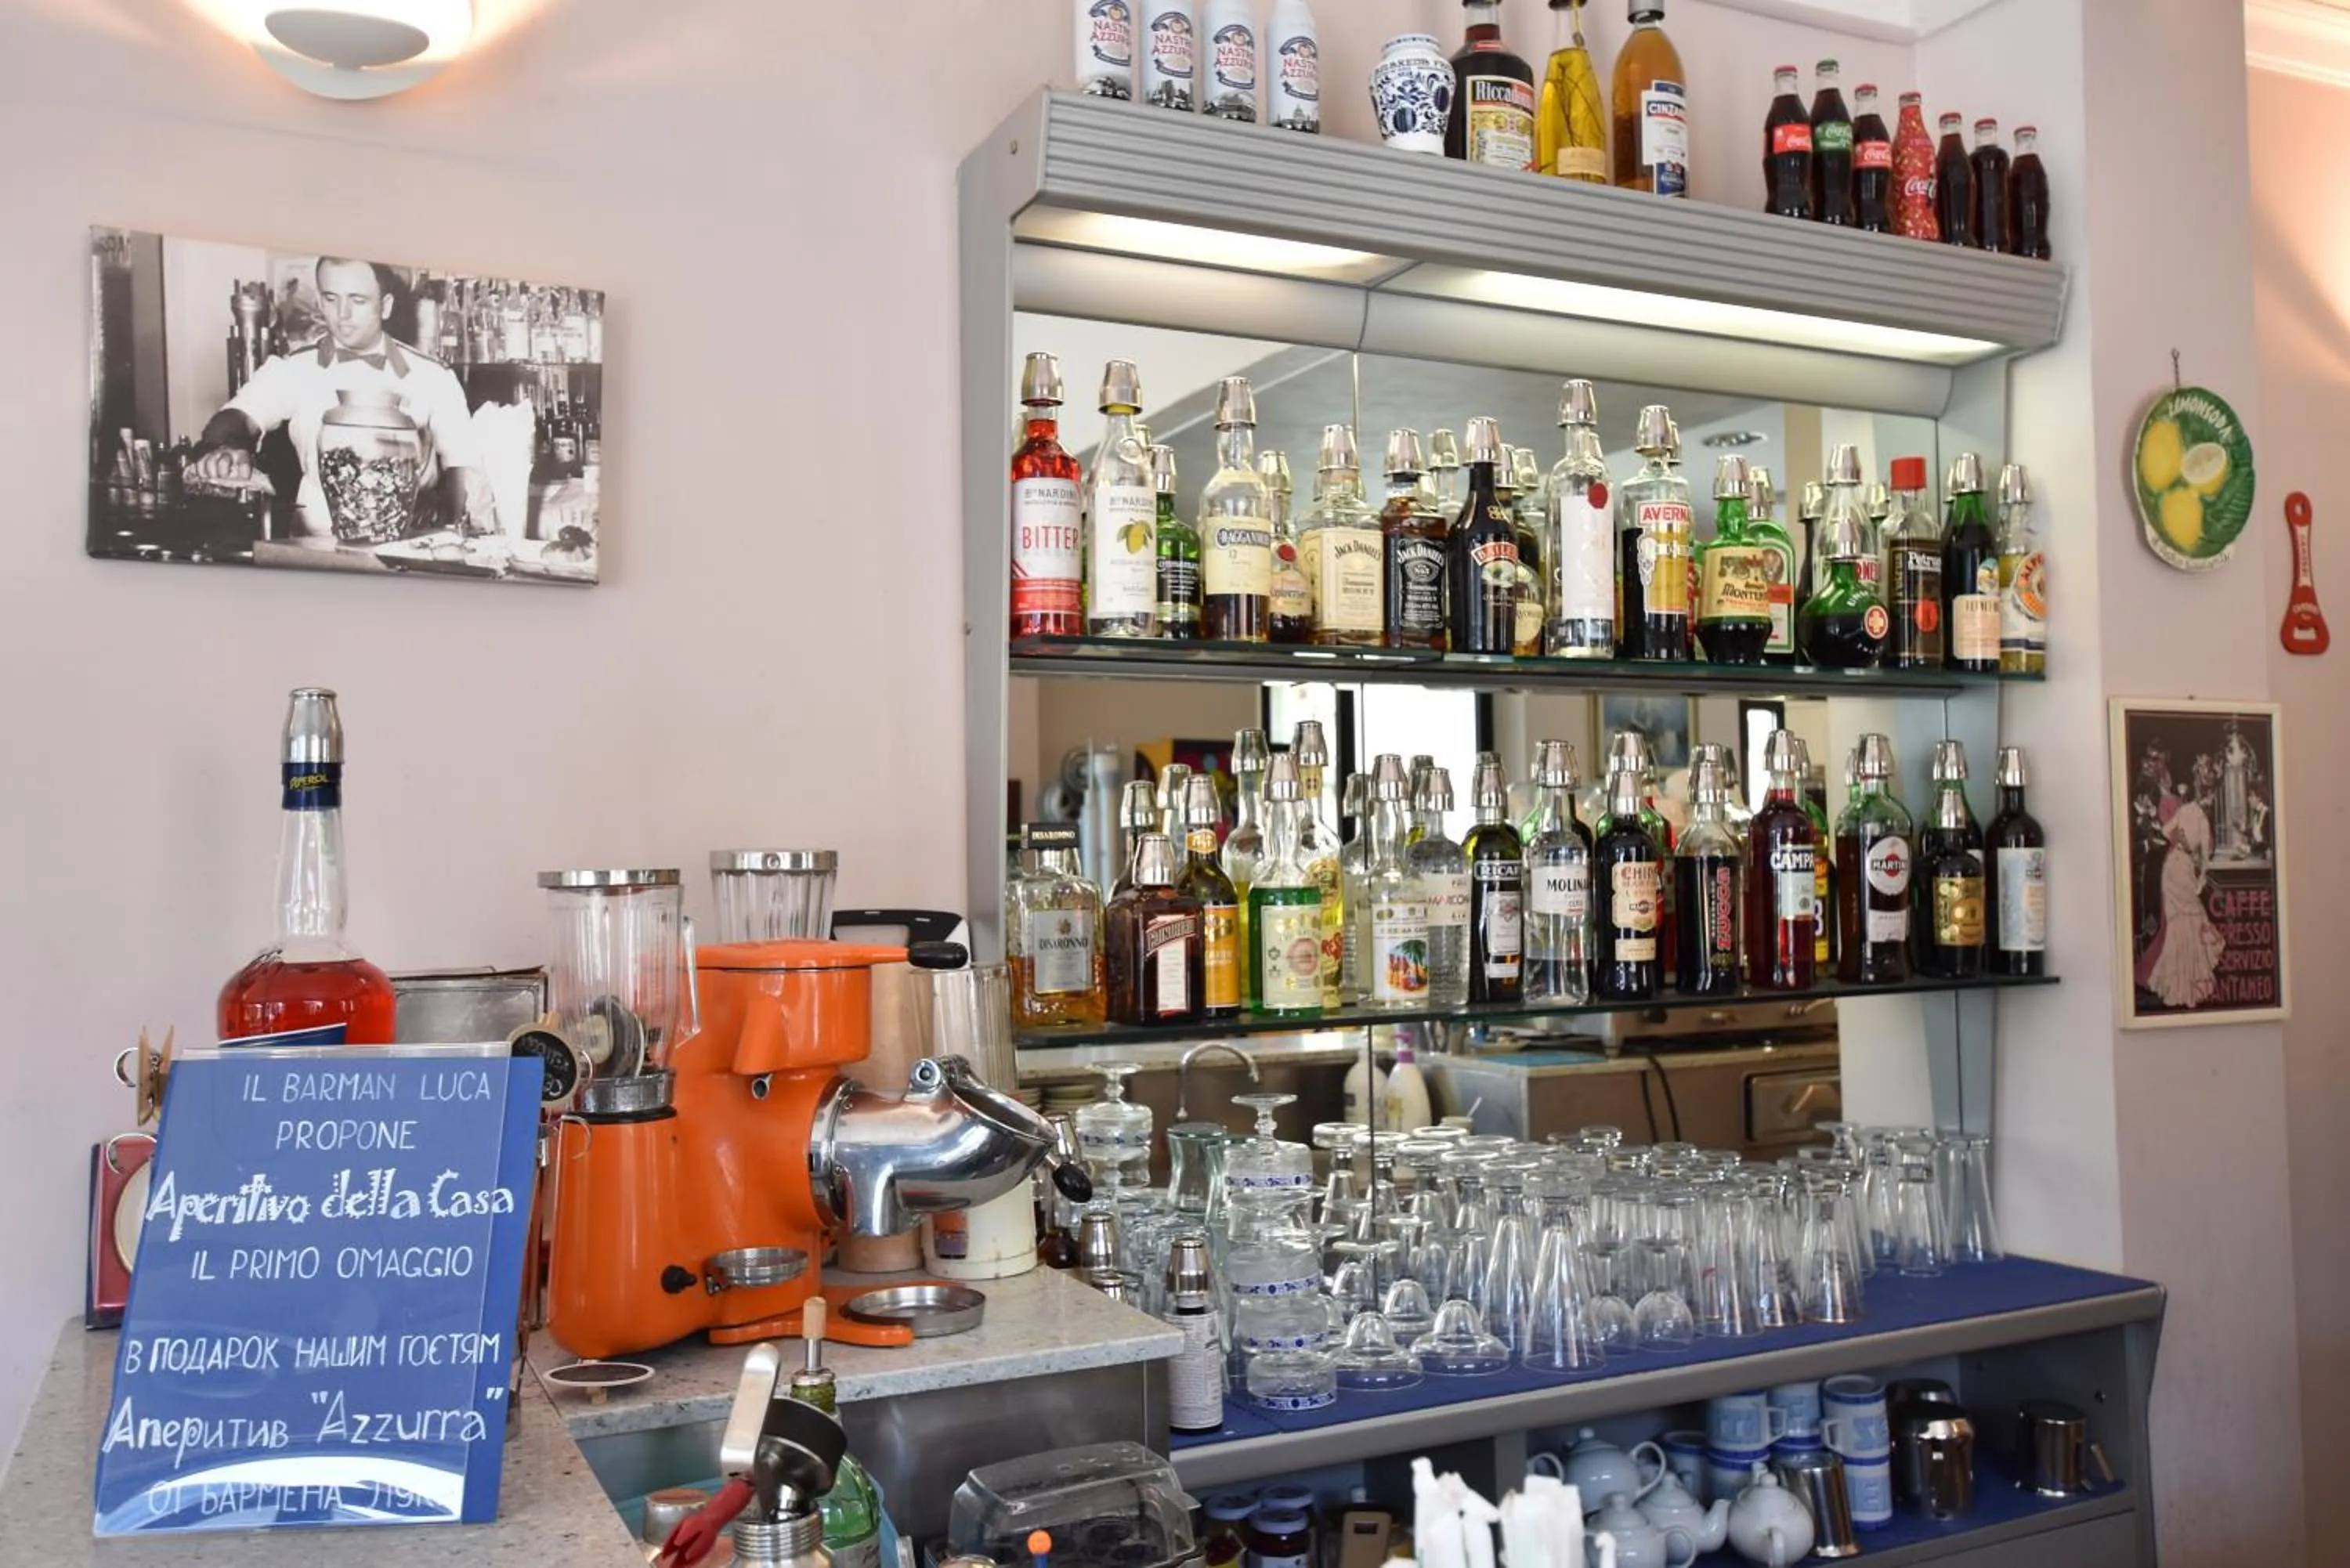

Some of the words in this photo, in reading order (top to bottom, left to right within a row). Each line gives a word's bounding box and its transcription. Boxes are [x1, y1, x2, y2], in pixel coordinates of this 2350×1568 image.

[2168, 396, 2232, 439] LEMONSODA
[1022, 526, 1079, 550] BITTER
[1397, 548, 1418, 564] JACK
[290, 774, 329, 789] APEROL
[243, 1073, 267, 1102] IL
[283, 1072, 396, 1103] BARMAN
[420, 1071, 492, 1102] LUCA
[276, 1120, 419, 1151] PROPONE
[146, 1171, 312, 1243] Aperitivo
[321, 1167, 422, 1219] della
[428, 1169, 515, 1219] Casa
[190, 1250, 215, 1281] IL
[229, 1247, 320, 1280] PRIMO
[336, 1246, 474, 1279] OMAGGIO
[125, 1340, 142, 1375] В
[149, 1336, 280, 1375] ПОДАРОК
[295, 1334, 387, 1368] НАШИМ
[101, 1395, 290, 1469] Аперитив
